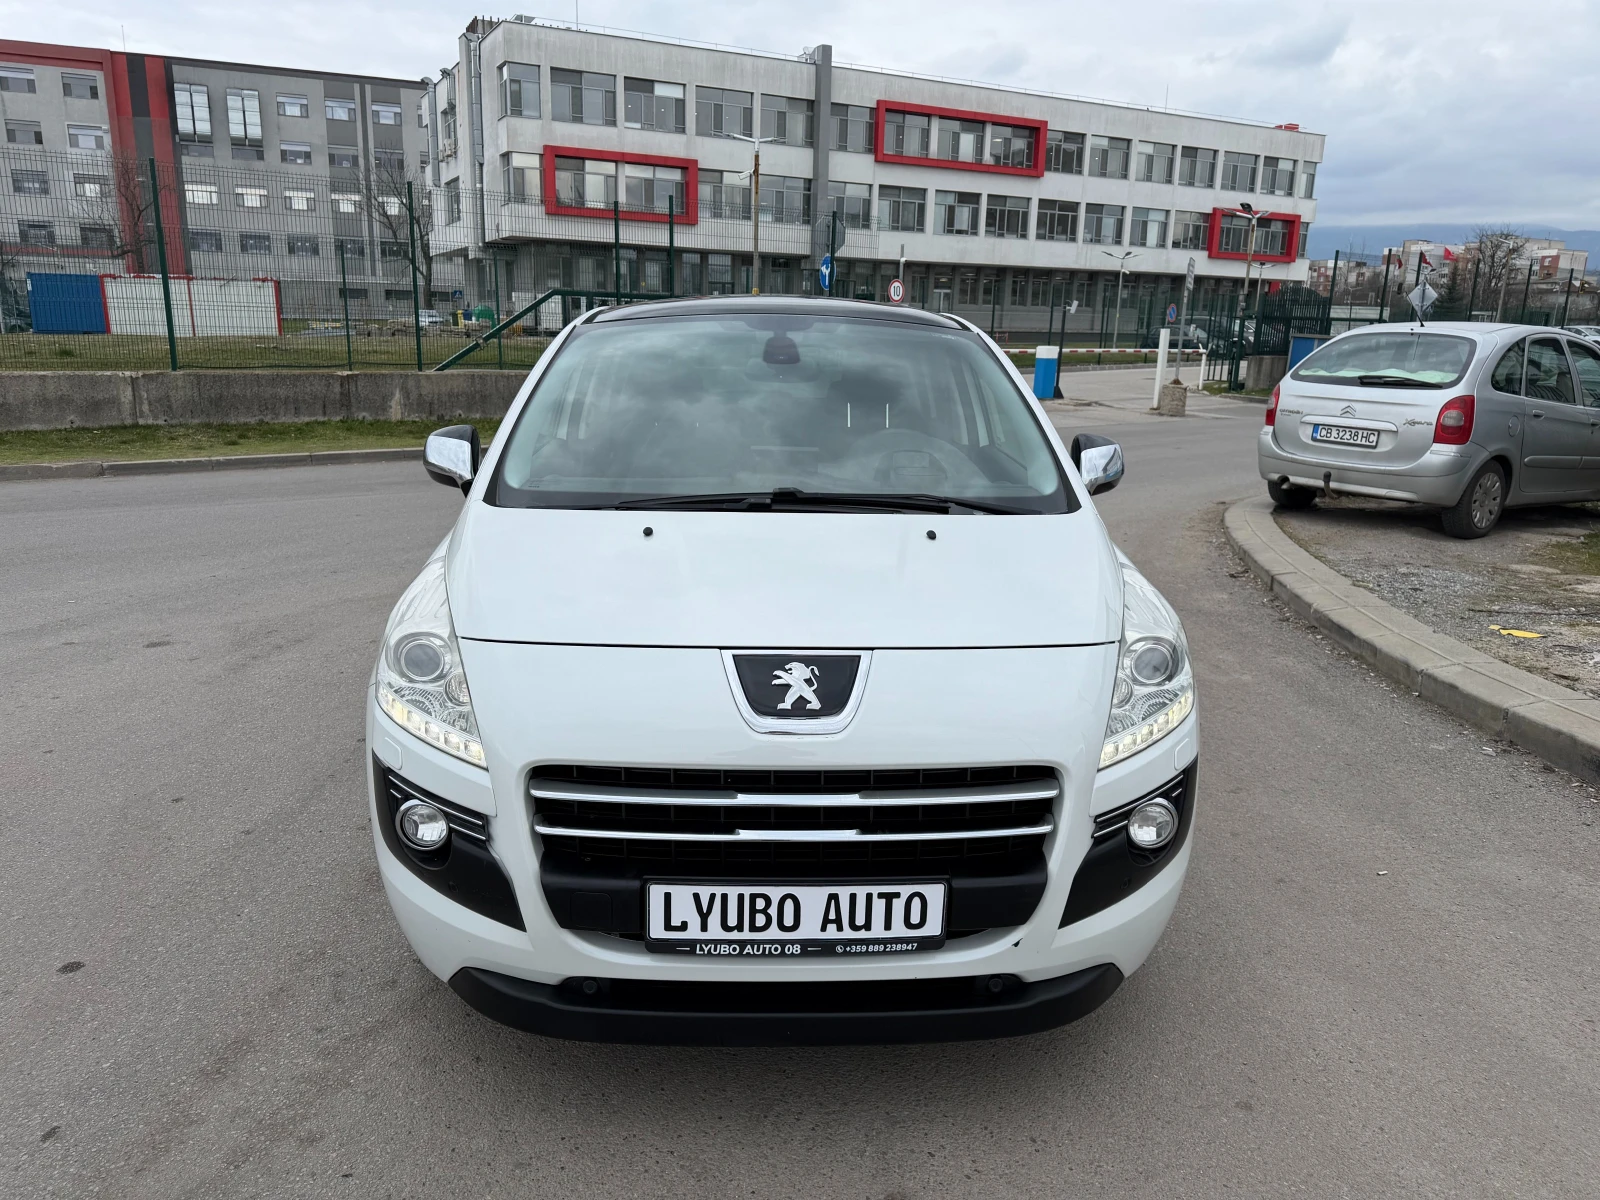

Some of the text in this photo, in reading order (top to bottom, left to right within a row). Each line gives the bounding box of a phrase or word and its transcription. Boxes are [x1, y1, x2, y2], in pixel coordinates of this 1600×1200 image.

[893, 285, 901, 297] 10
[1319, 427, 1376, 444] CB 3238 HC
[663, 891, 928, 933] LYUBO AUTO
[695, 943, 801, 955] LYUBO AUTO 08
[845, 943, 918, 953] +359 889 238947
